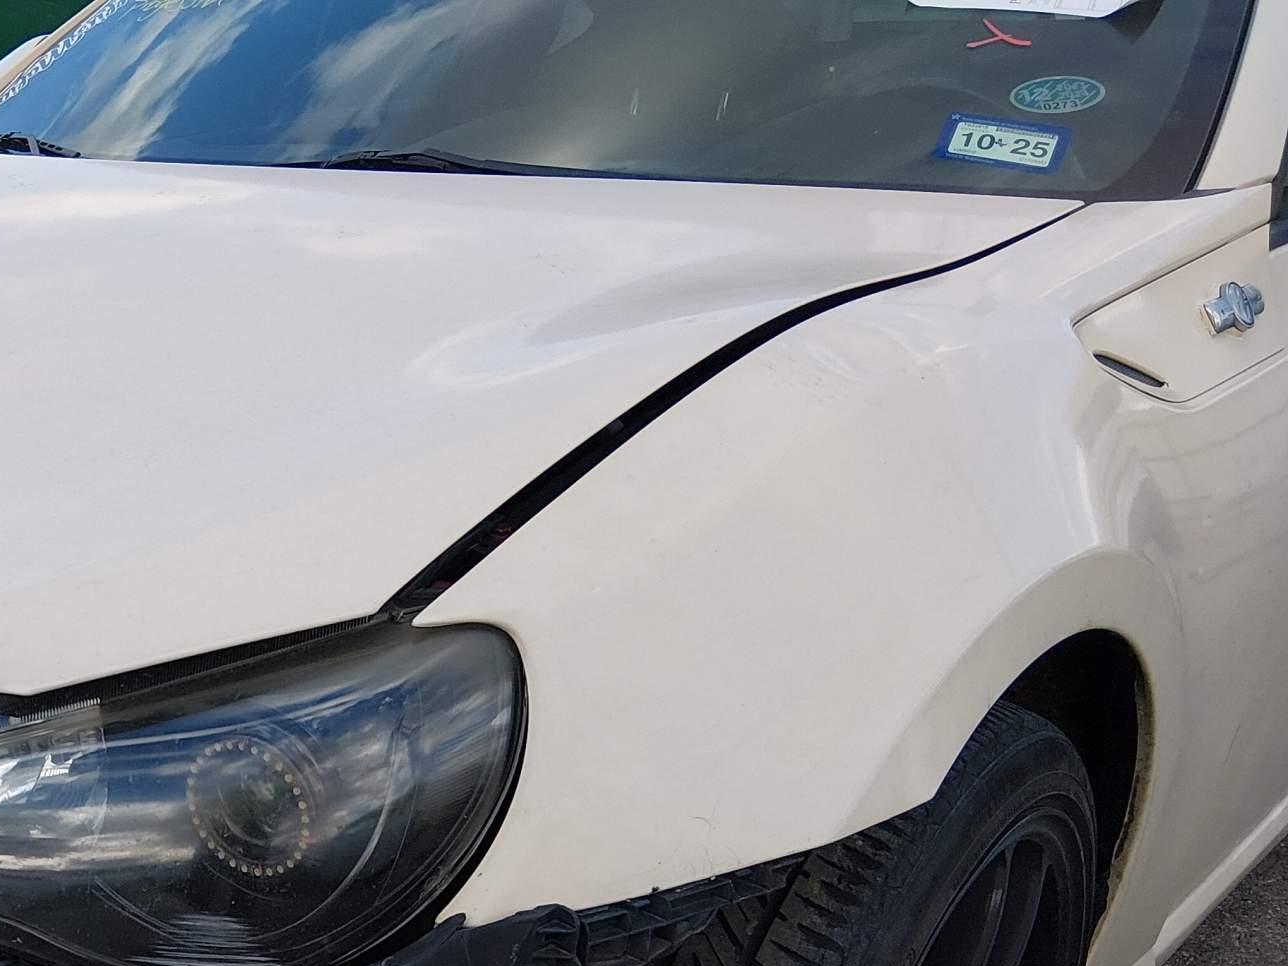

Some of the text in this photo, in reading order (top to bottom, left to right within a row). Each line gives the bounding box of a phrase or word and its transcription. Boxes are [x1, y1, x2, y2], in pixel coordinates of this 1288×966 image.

[1043, 102, 1078, 111] 0273
[962, 132, 996, 150] 10
[1010, 139, 1050, 158] 25
